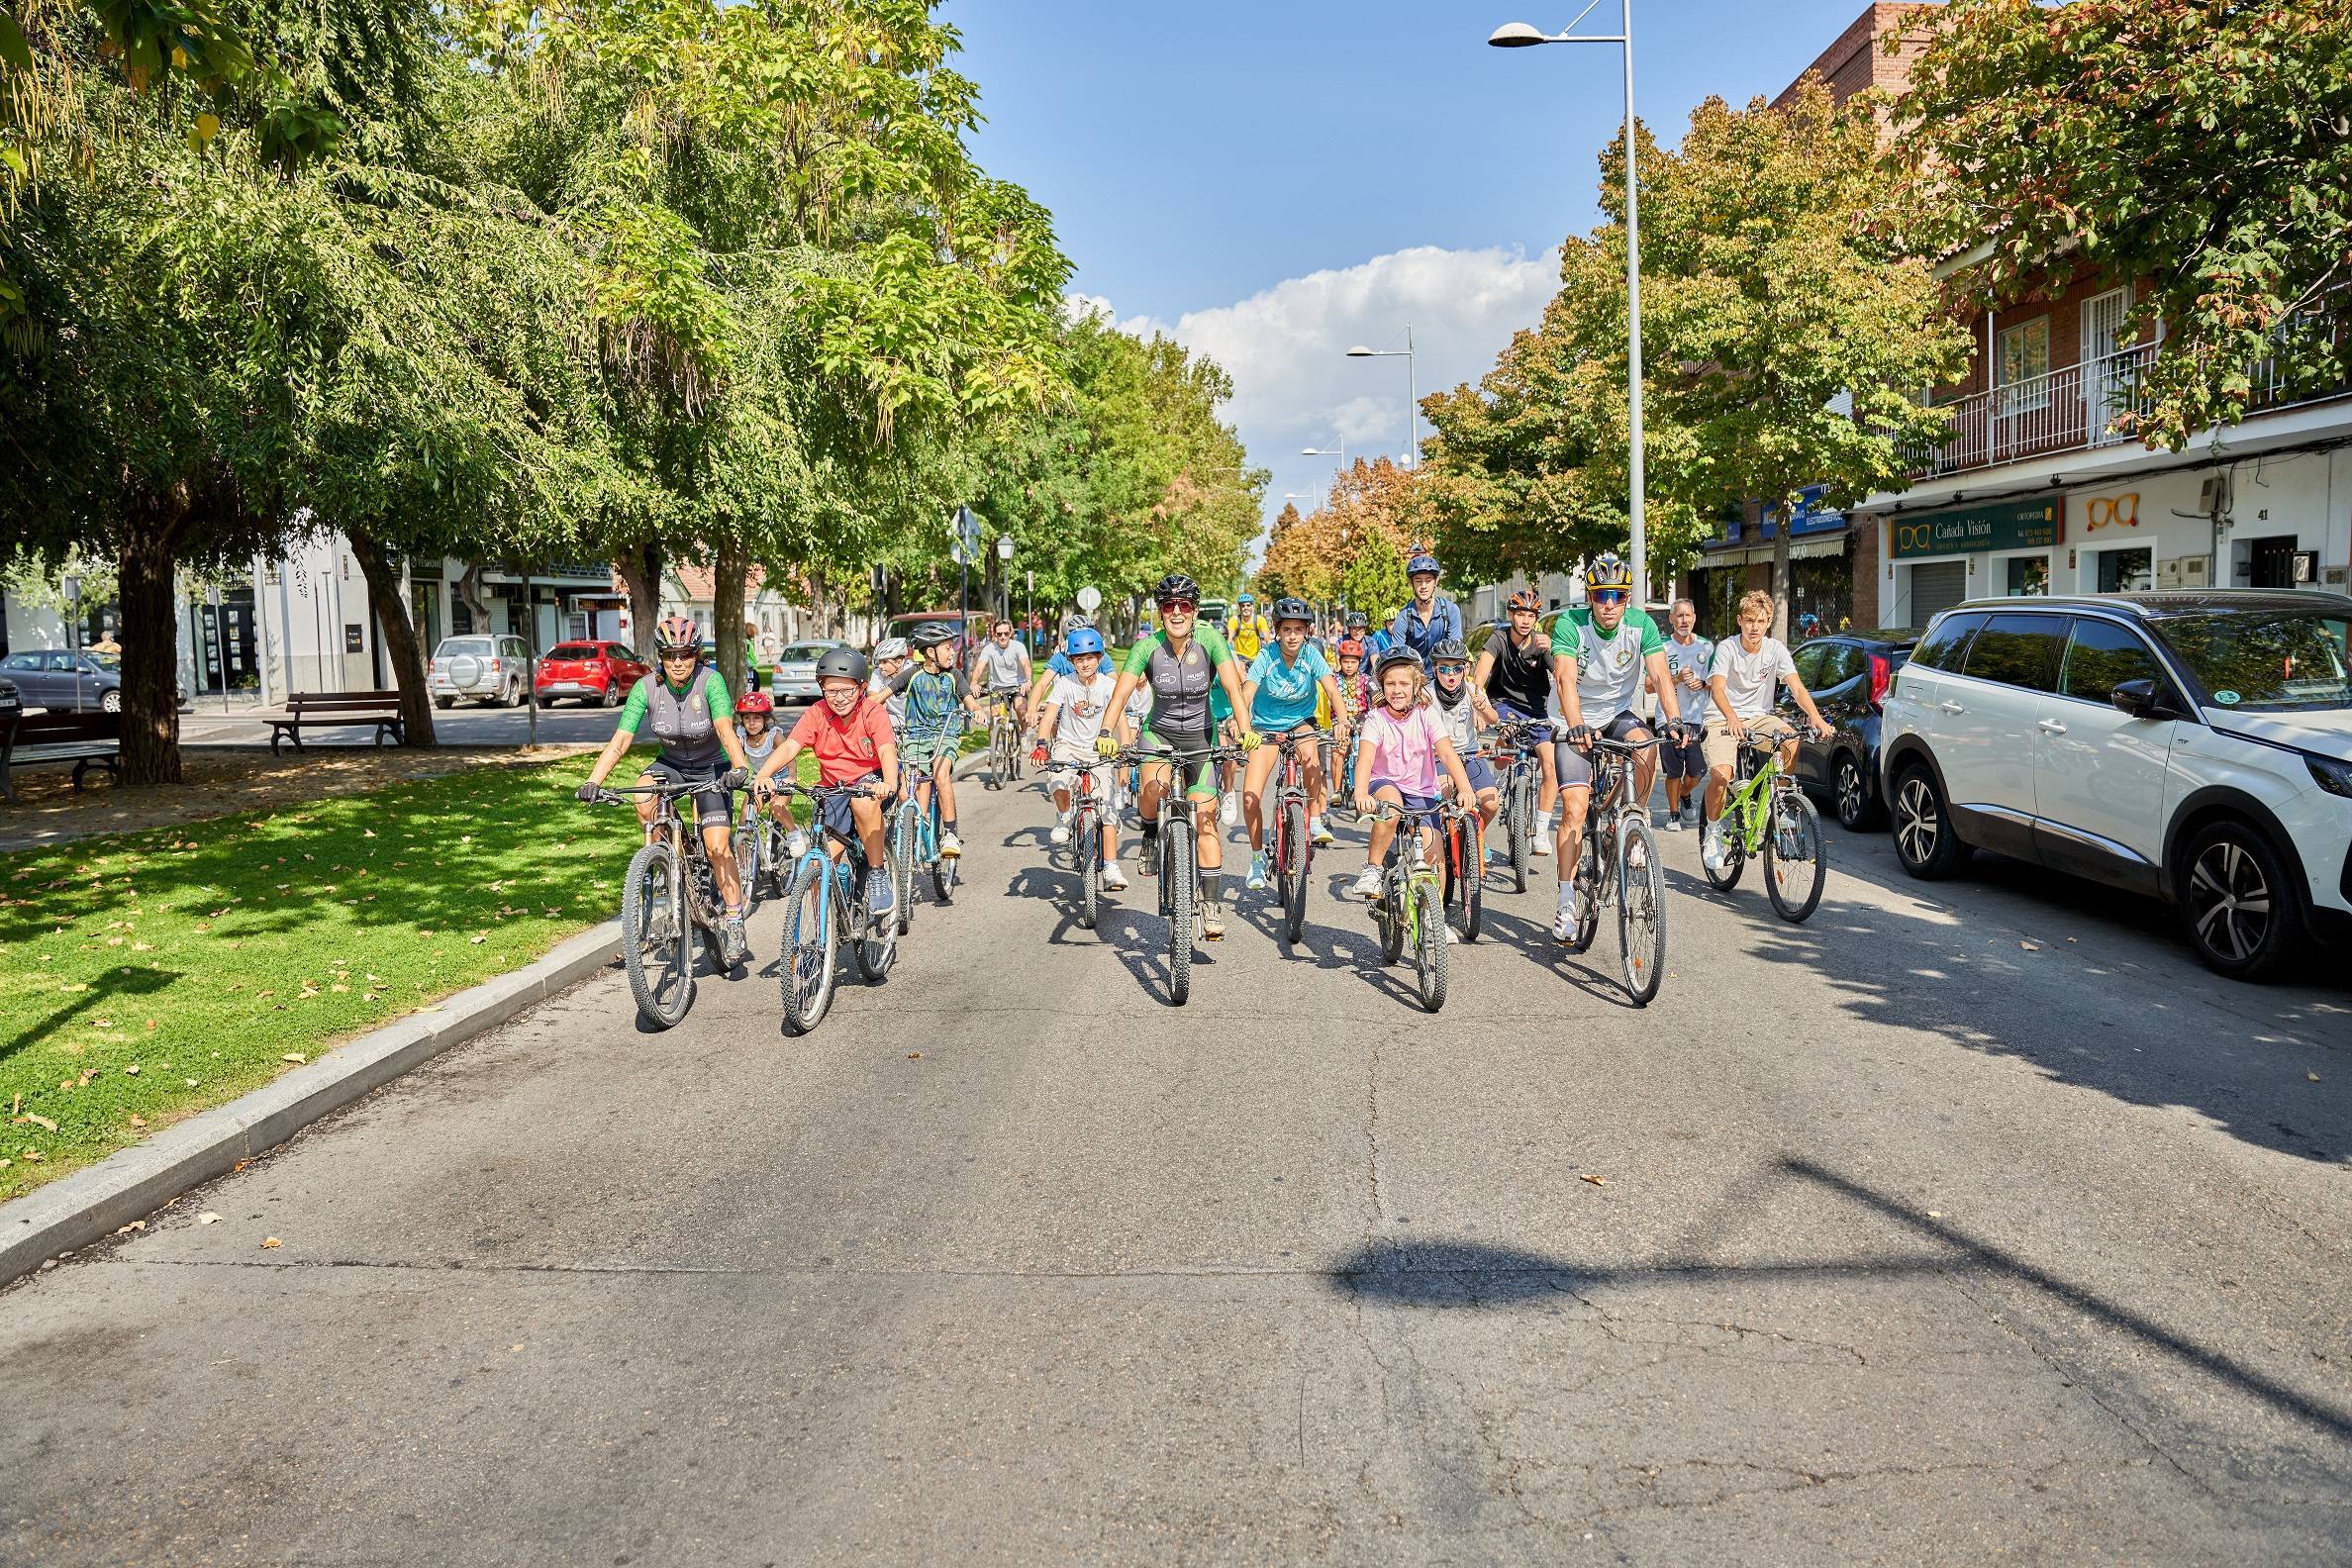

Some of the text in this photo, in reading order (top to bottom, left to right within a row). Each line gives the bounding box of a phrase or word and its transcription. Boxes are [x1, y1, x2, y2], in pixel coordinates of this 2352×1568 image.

[2258, 509, 2268, 521] 41
[1935, 519, 1992, 539] Cañada Visión
